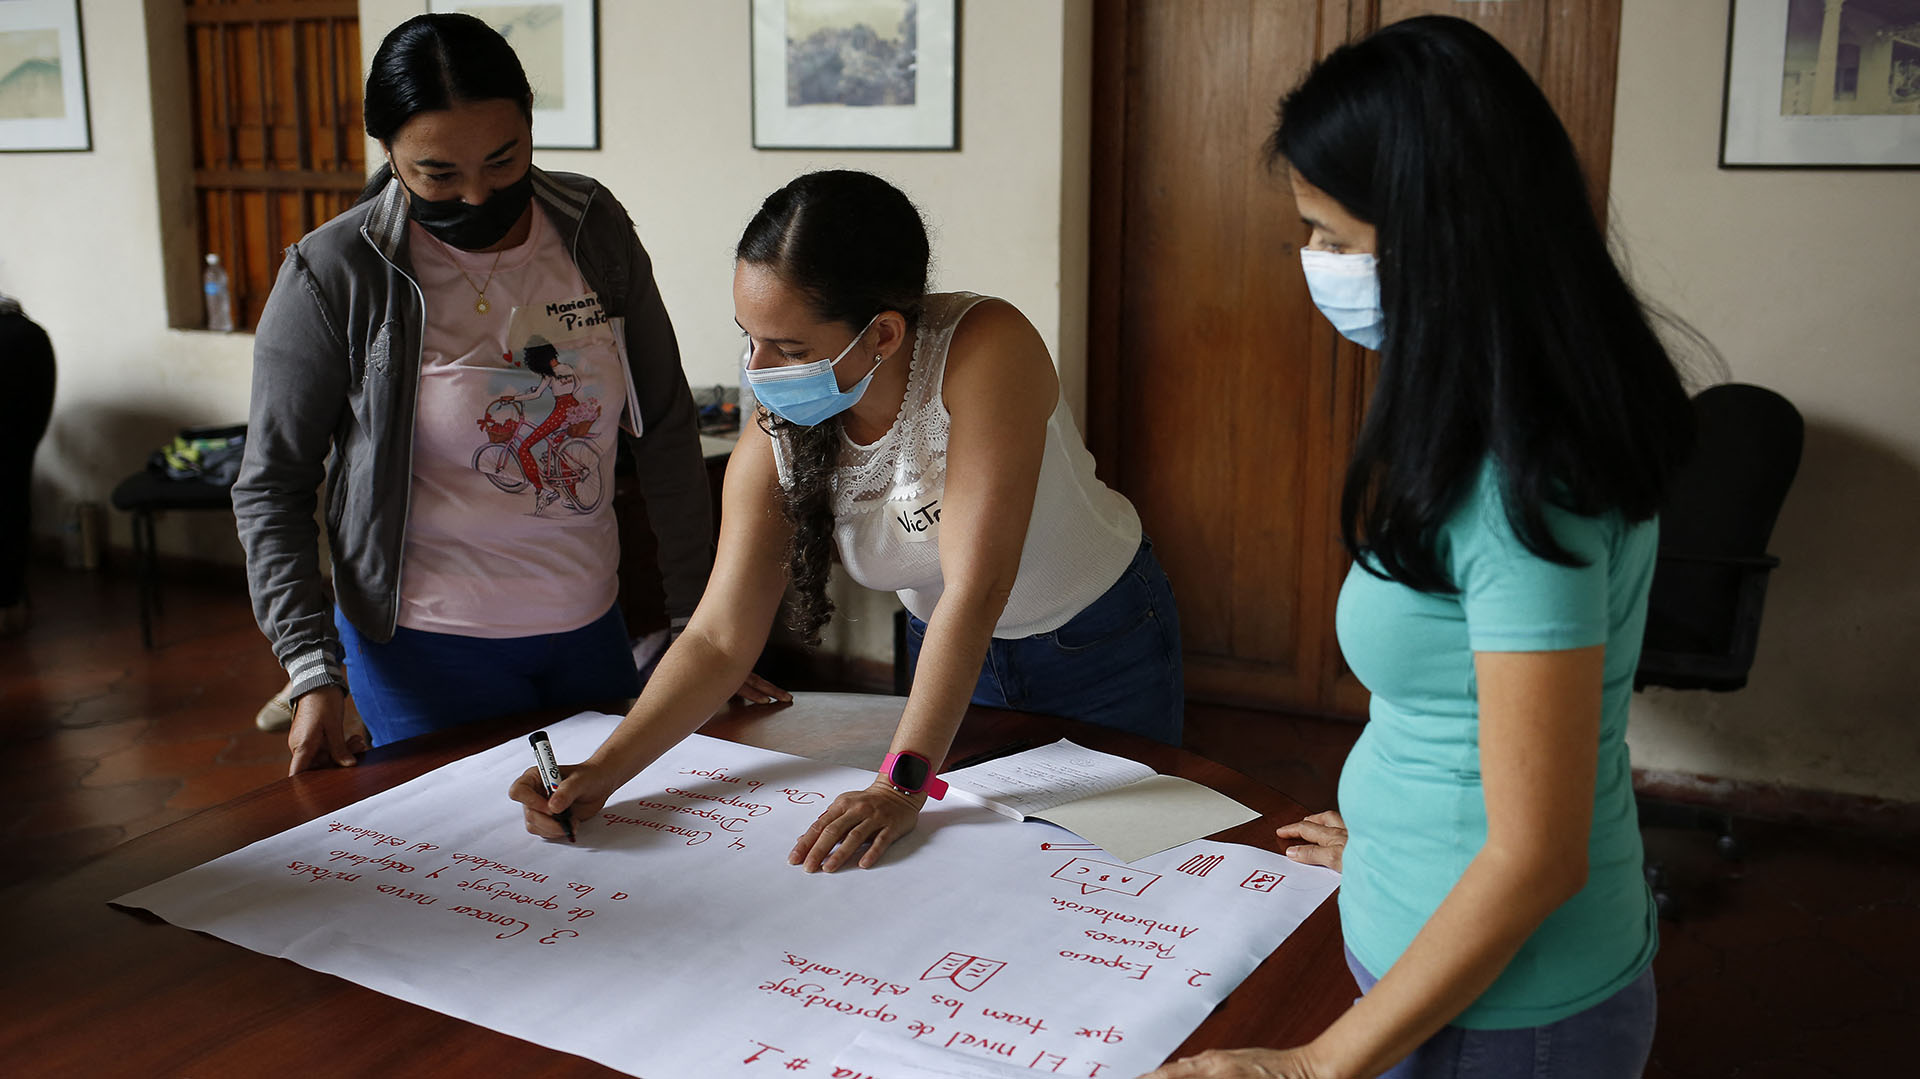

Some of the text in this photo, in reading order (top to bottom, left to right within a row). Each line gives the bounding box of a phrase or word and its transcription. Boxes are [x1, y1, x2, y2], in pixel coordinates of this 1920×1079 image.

[747, 780, 765, 793] lo
[776, 788, 825, 804] Dar
[665, 787, 772, 817] Compromiso
[404, 842, 440, 853] del
[457, 878, 558, 910] aprendizaje
[567, 882, 595, 899] las
[610, 892, 628, 903] a
[568, 907, 595, 921] de
[1050, 897, 1199, 939] Ambientación
[1084, 930, 1176, 959] Recursos
[1059, 950, 1211, 987] 2. Espacio
[758, 978, 898, 1022] aprendizaje
[931, 994, 964, 1019] los
[907, 1020, 935, 1039] de
[1075, 1026, 1123, 1044] que
[1029, 1051, 1067, 1072] El
